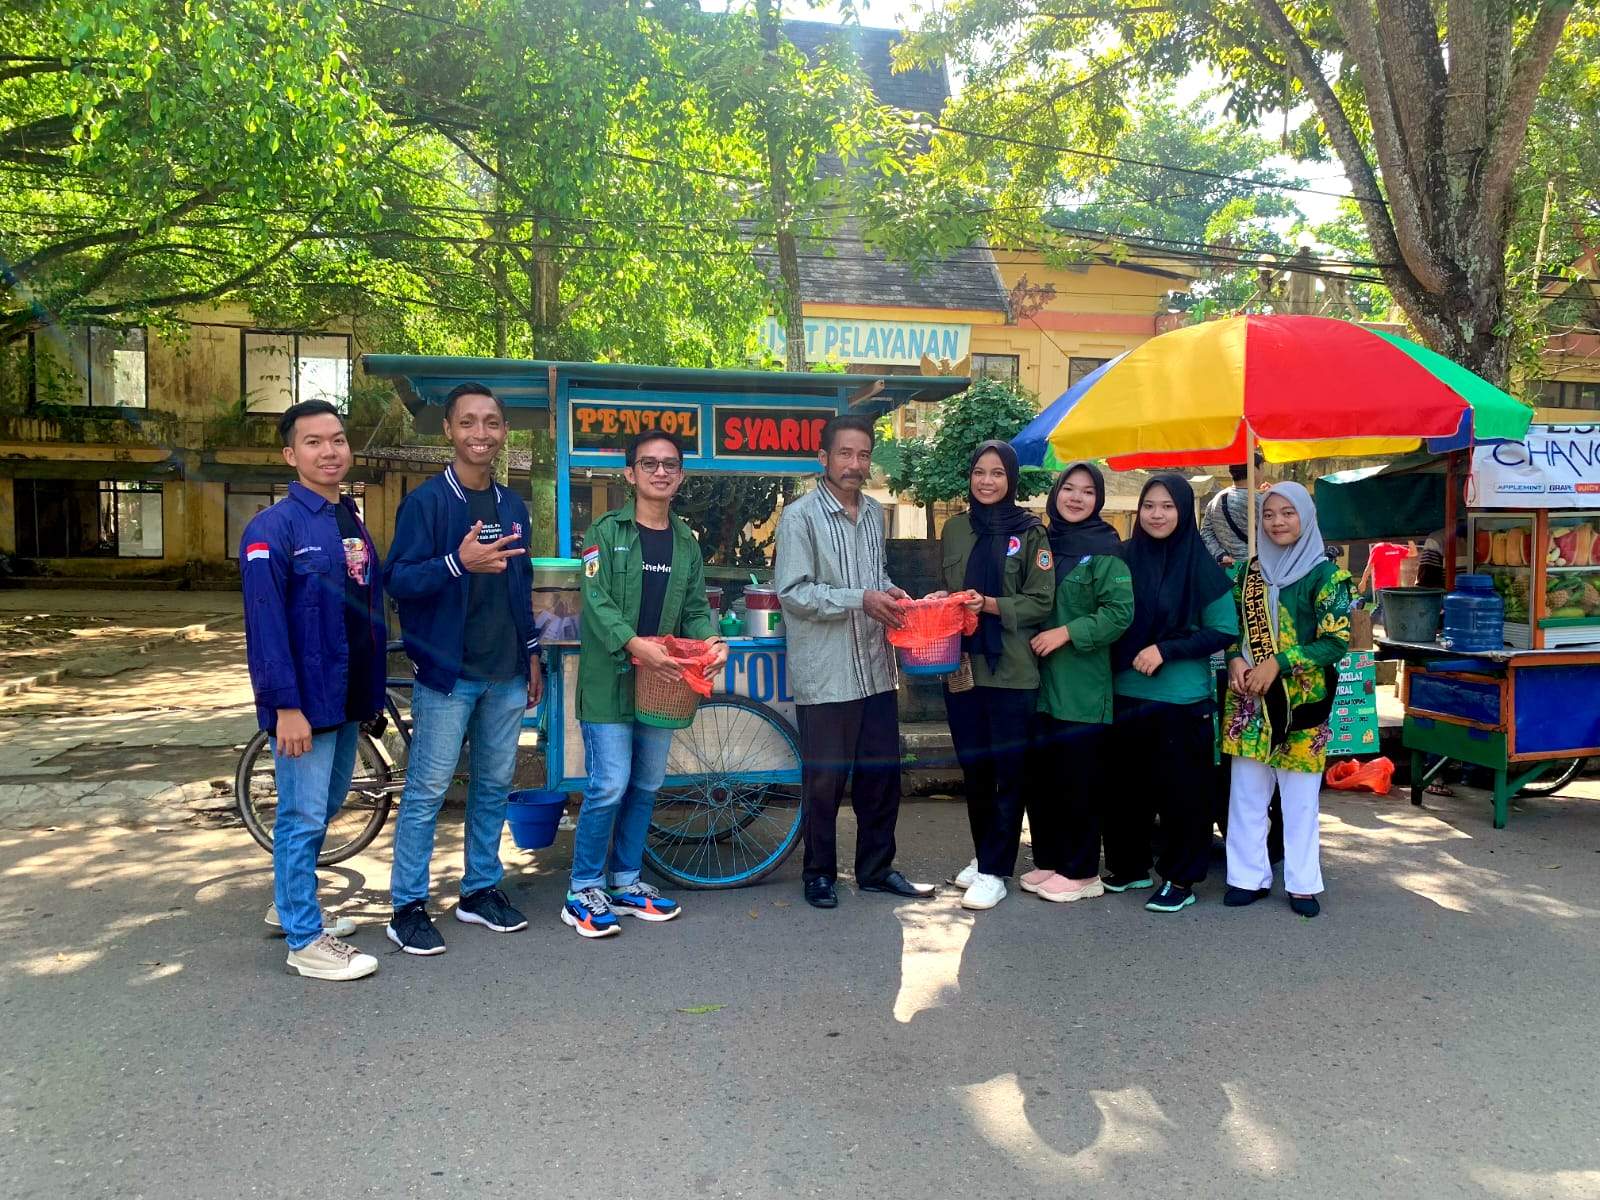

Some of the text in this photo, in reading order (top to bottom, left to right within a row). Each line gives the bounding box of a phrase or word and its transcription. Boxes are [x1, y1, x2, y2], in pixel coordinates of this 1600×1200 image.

[824, 325, 960, 360] PELAYANAN
[576, 407, 697, 437] PENTOL
[1492, 439, 1600, 477] CHAN
[1246, 574, 1265, 665] KABUPATEN HS
[1255, 598, 1274, 660] PEPELINGAS
[725, 652, 795, 703] TOL
